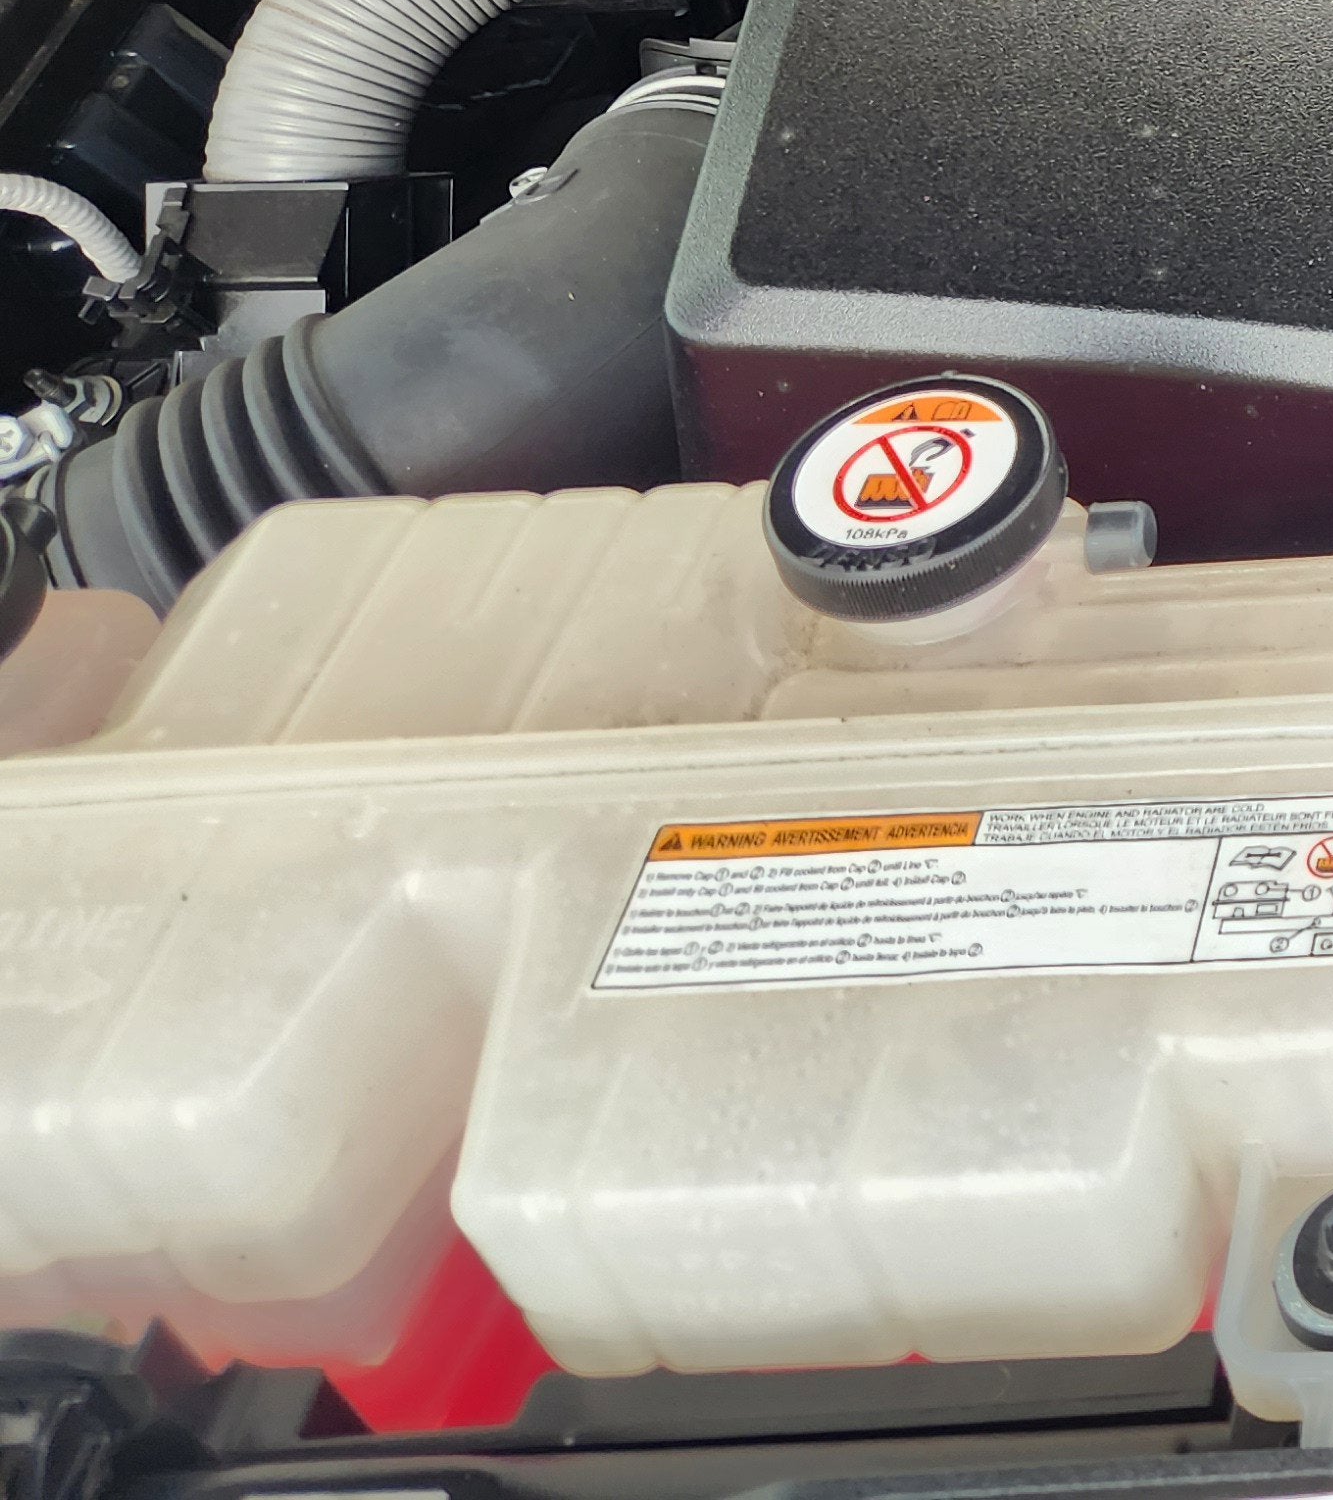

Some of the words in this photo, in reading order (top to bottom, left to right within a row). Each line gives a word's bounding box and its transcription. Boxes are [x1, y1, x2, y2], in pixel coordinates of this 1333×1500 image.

[844, 527, 909, 541] 108kPa
[989, 813, 1025, 822] WORK
[1115, 809, 1140, 818] AND
[1142, 806, 1202, 817] RADIATOR
[1205, 805, 1226, 814] ARE
[1231, 803, 1265, 813] COLD
[691, 832, 765, 849] WARNING
[773, 828, 881, 846] AVERTISSEMENT
[887, 822, 969, 838] ADVERTENCIA
